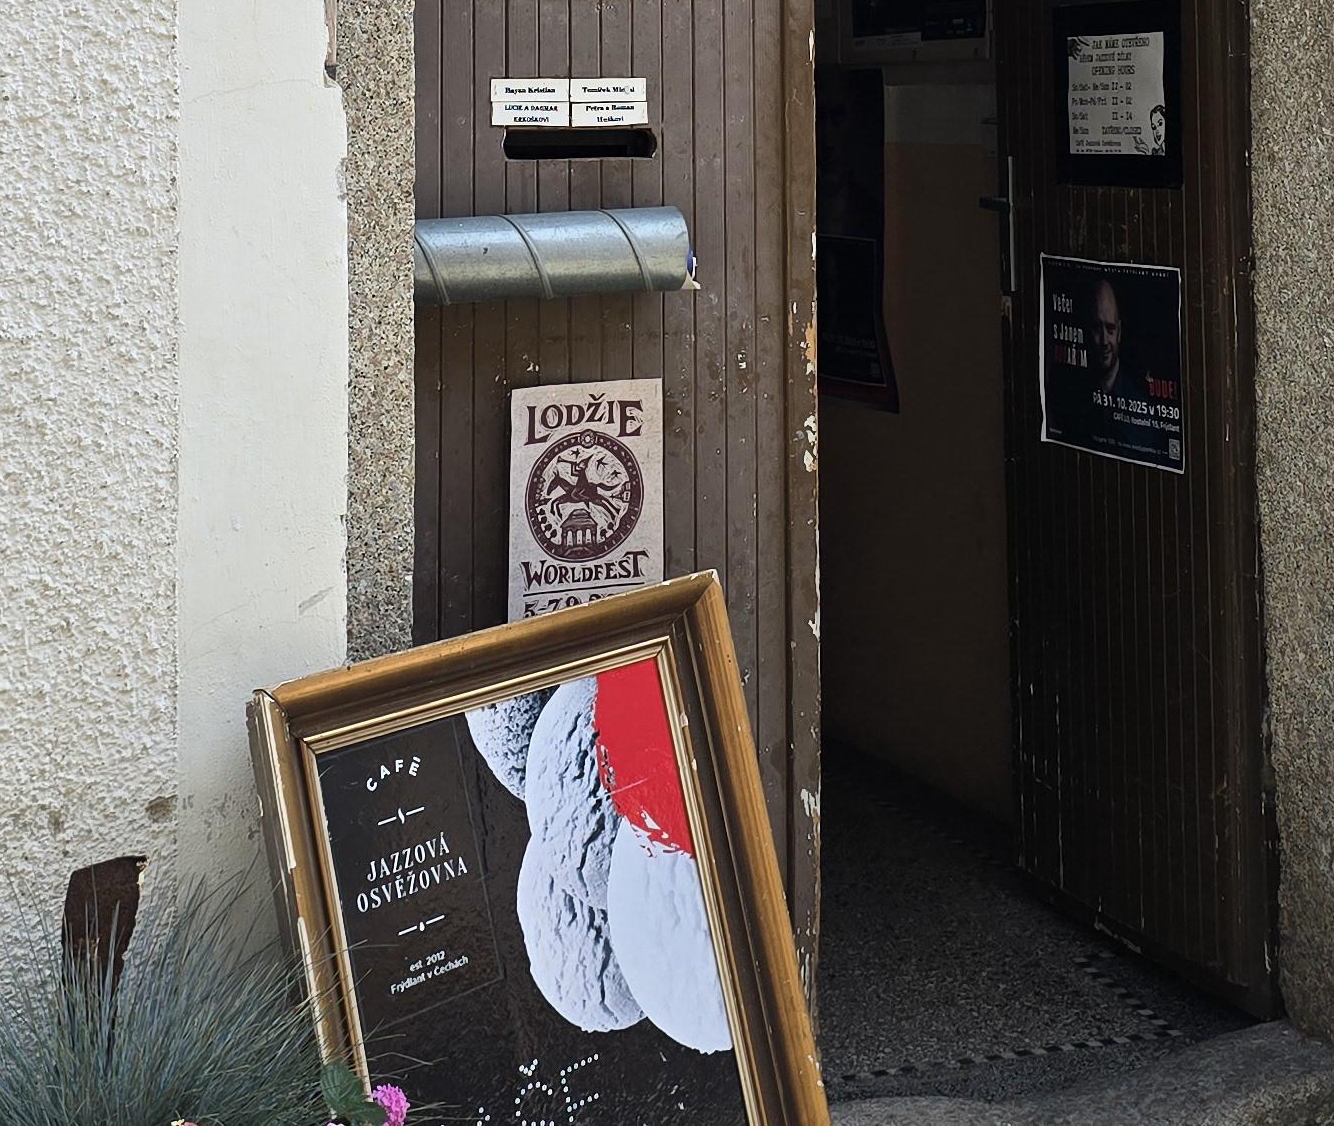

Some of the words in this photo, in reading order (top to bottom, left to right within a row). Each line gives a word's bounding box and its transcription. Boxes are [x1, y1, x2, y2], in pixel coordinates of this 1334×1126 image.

[1092, 65, 1116, 75] OPENING
[524, 393, 644, 446] LODŽIE
[1156, 404, 1180, 420] 19:30
[521, 550, 650, 592] WORLDFEST
[367, 832, 450, 882] JAZZOVÁ
[356, 856, 468, 914] OSVĚŽOVNA
[390, 972, 426, 995] Frýdlant
[433, 955, 469, 975] Čechách
[426, 950, 446, 966] 2012
